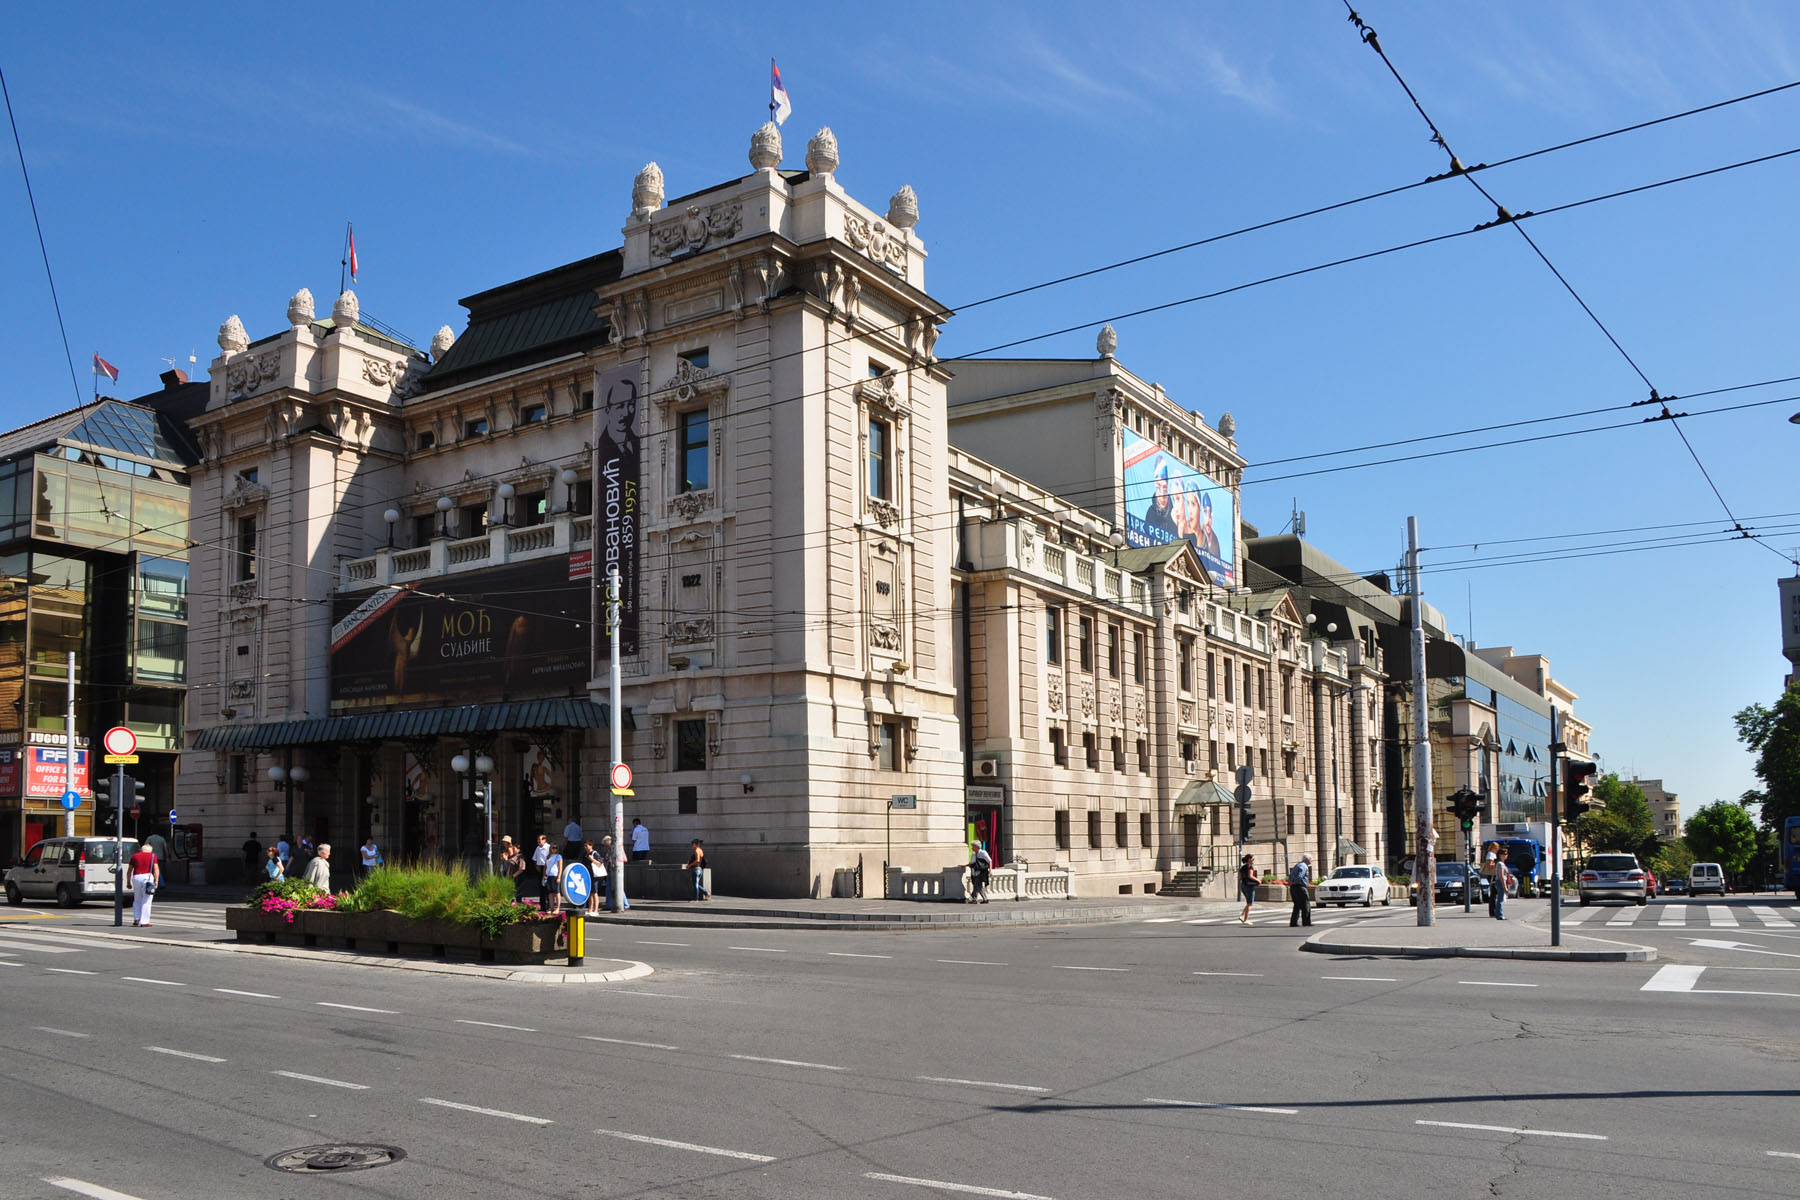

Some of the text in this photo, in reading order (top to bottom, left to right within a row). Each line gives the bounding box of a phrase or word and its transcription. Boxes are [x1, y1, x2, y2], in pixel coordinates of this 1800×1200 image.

[625, 480, 637, 514] 1957
[622, 514, 634, 549] 1859
[441, 608, 492, 639] МОЋ
[440, 637, 492, 658] СУДБИНЕ
[30, 732, 91, 746] JUGODVO
[35, 765, 87, 775] OFFICE SACE
[42, 775, 59, 783] FOR
[897, 796, 909, 804] WC
